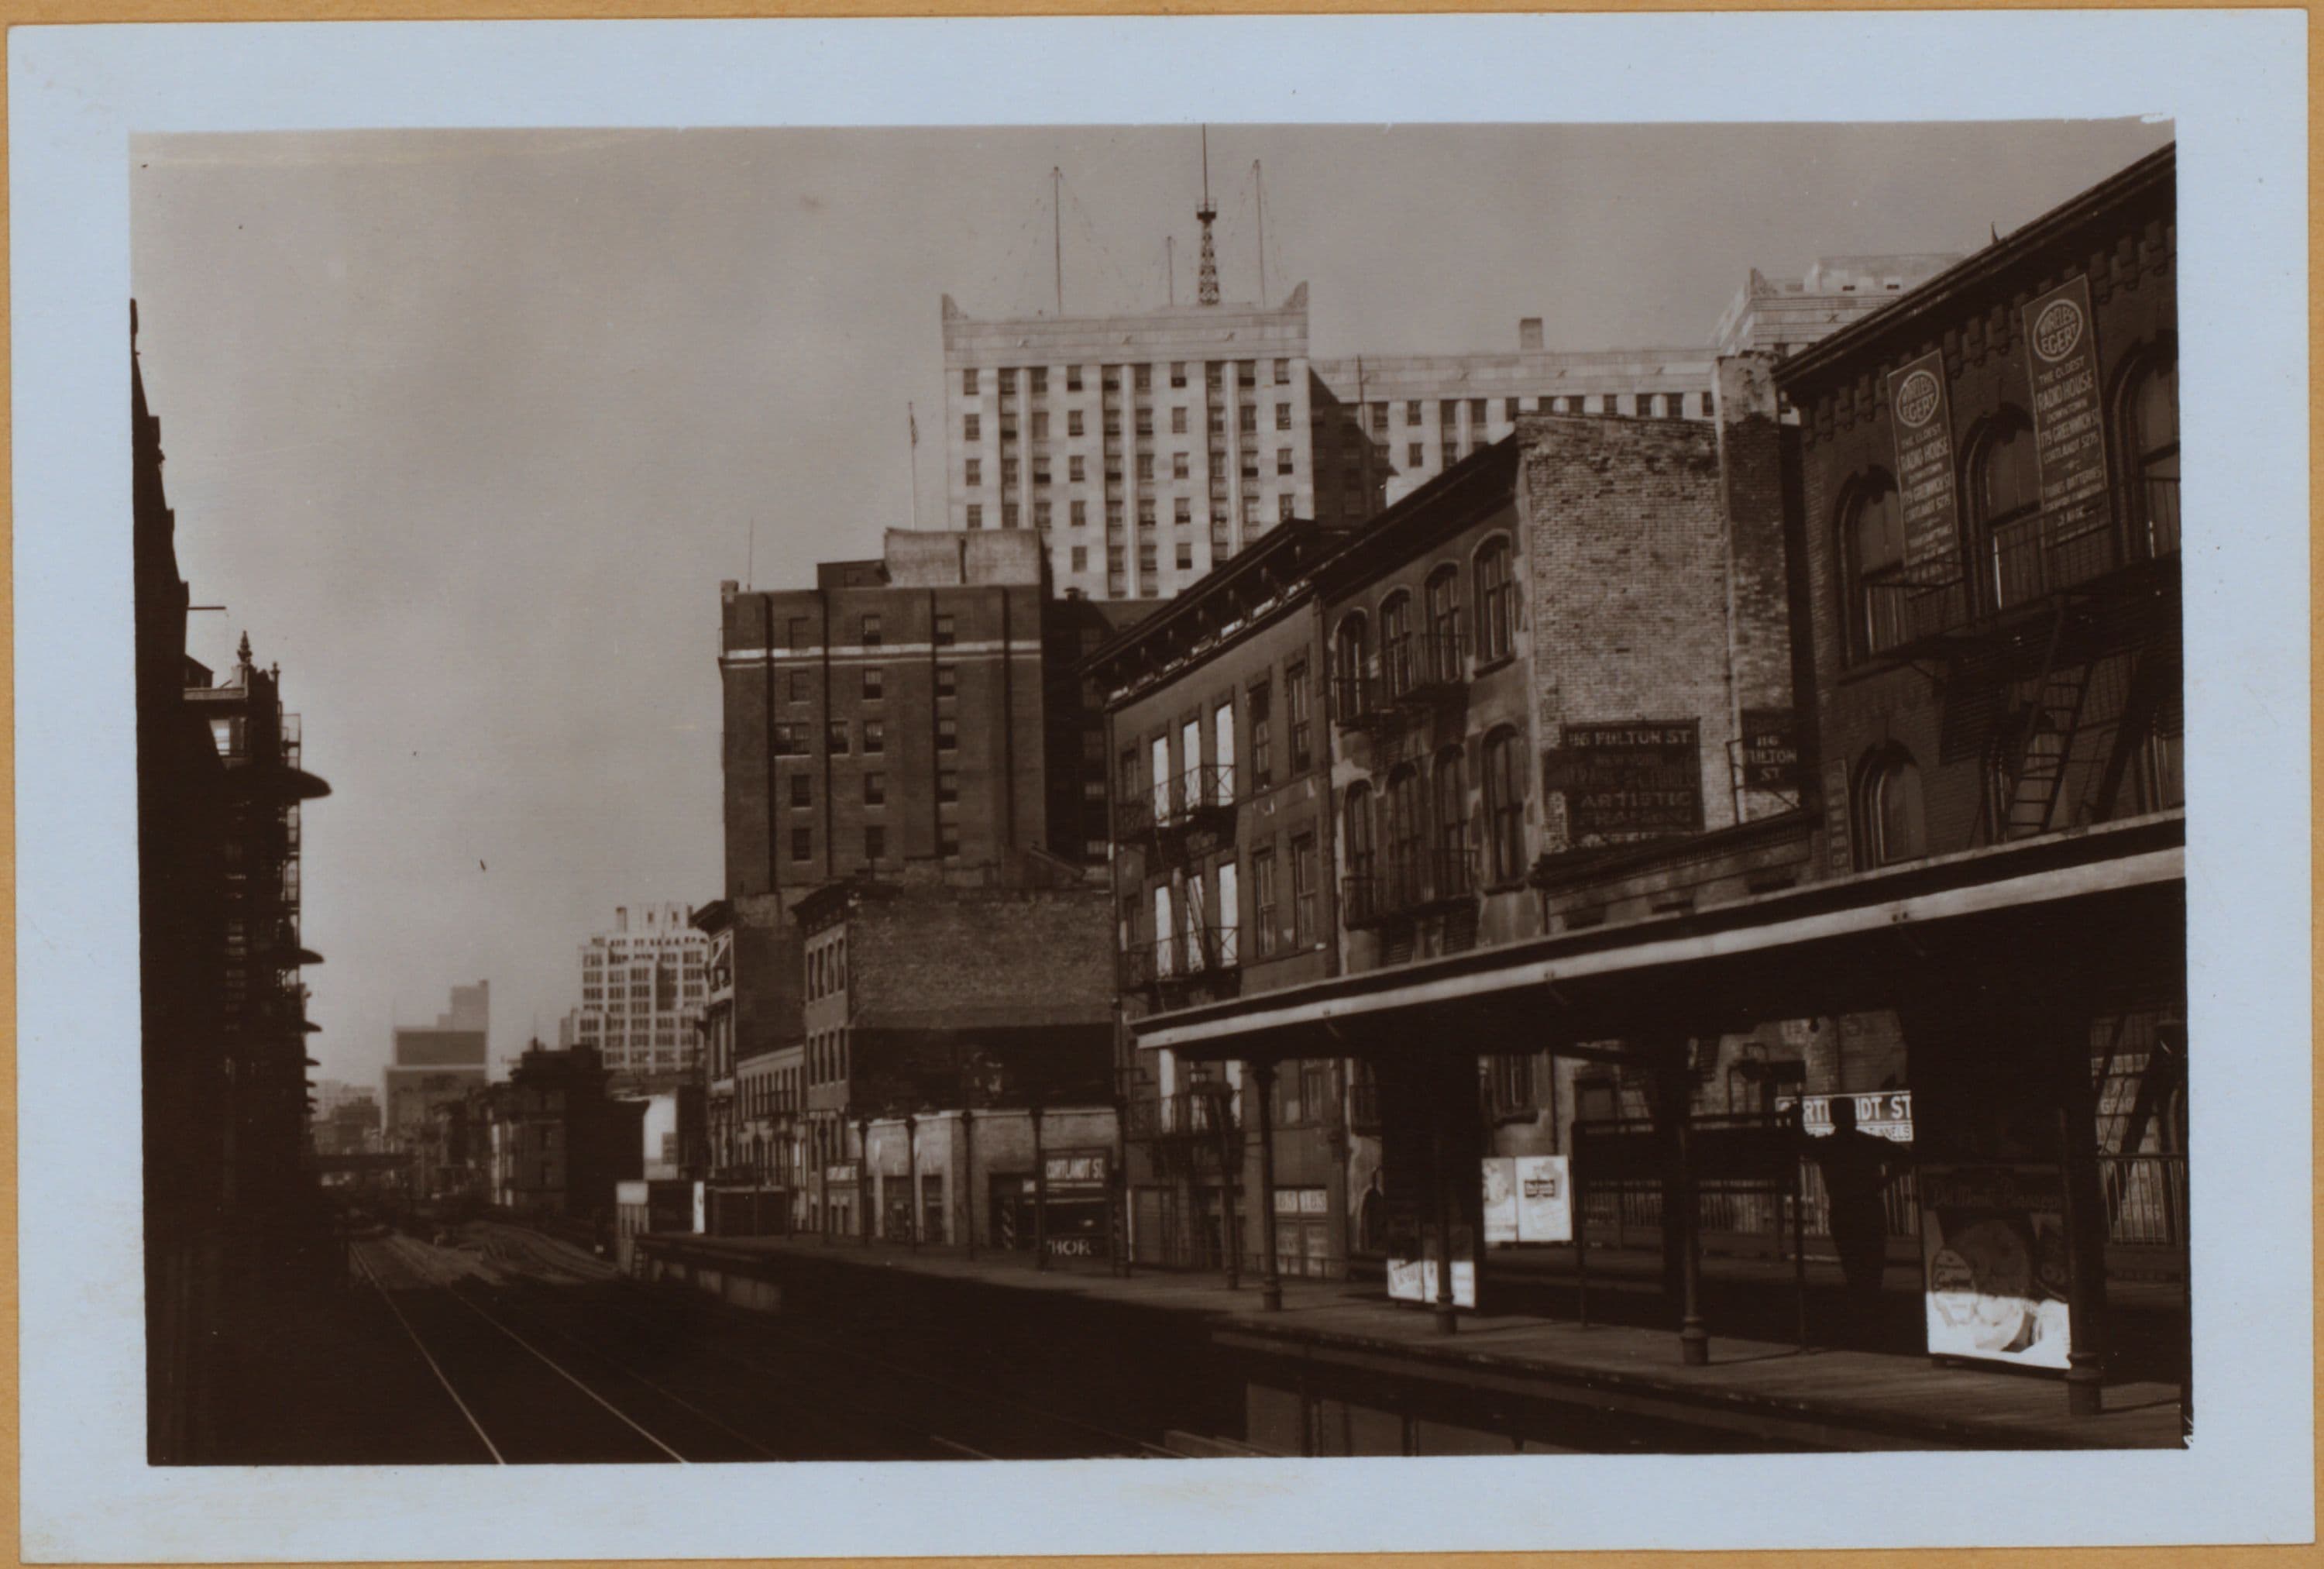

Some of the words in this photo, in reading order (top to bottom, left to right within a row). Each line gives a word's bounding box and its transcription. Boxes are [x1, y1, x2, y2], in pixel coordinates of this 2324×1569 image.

[2040, 322, 2078, 356] EGERT
[2038, 369, 2053, 387] THE
[2054, 353, 2085, 379] OLDEST
[1902, 391, 1935, 421] EGERT
[2036, 383, 2062, 413] RADIO
[2062, 367, 2093, 401] HOUSE
[1594, 731, 1662, 745] FULTON
[1666, 729, 1692, 744] ST
